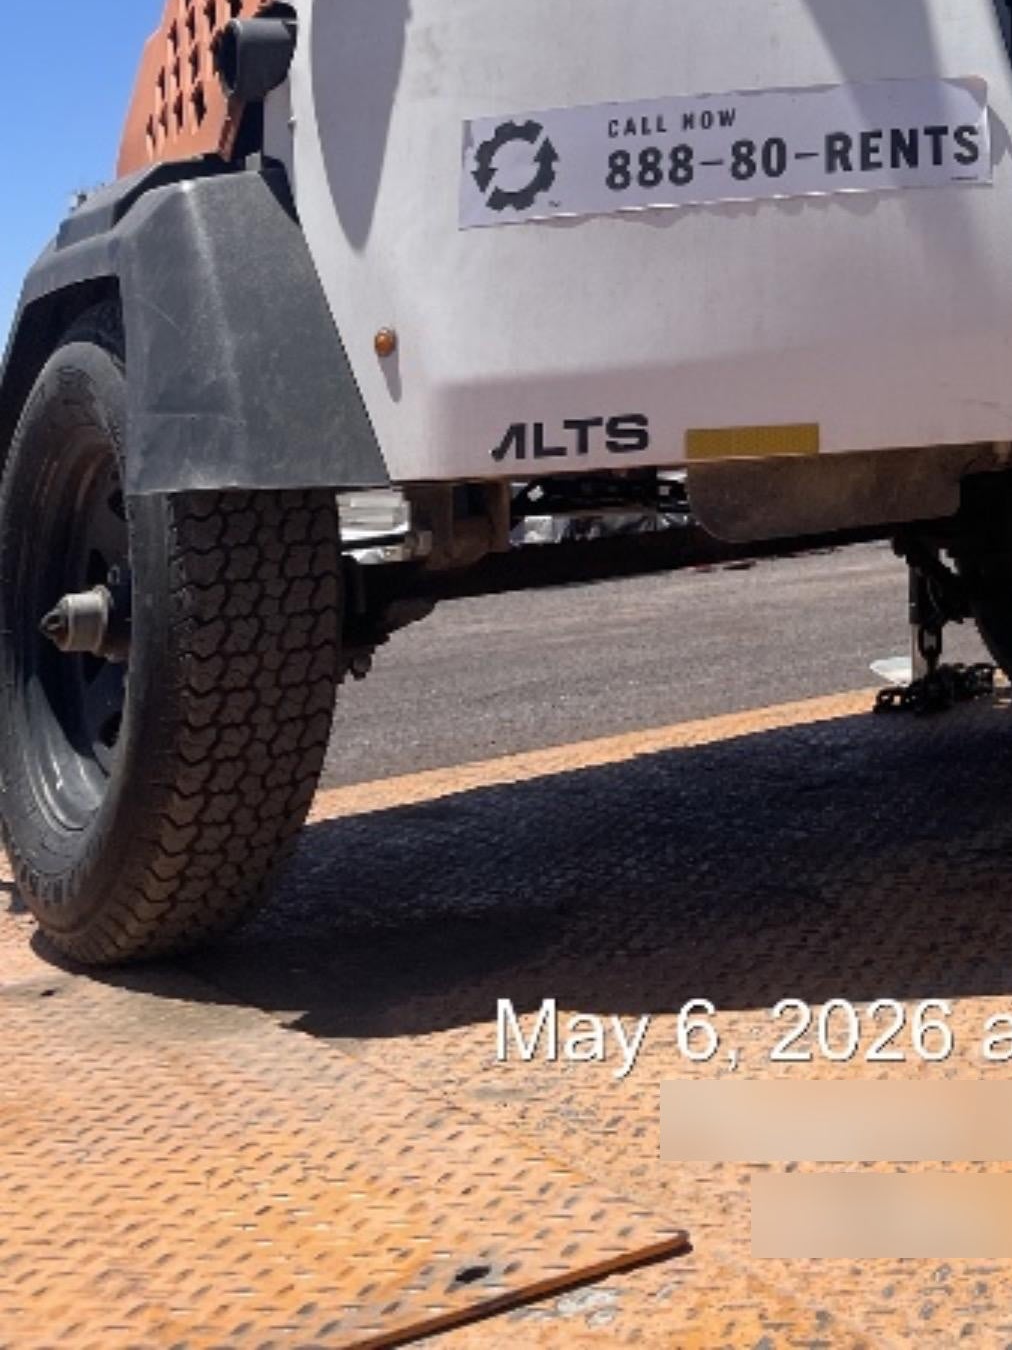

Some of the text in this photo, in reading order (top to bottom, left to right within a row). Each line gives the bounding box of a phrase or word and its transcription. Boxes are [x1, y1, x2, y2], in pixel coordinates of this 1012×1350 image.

[608, 107, 737, 139] CALL NOW
[605, 124, 980, 192] 888-80-RENTS
